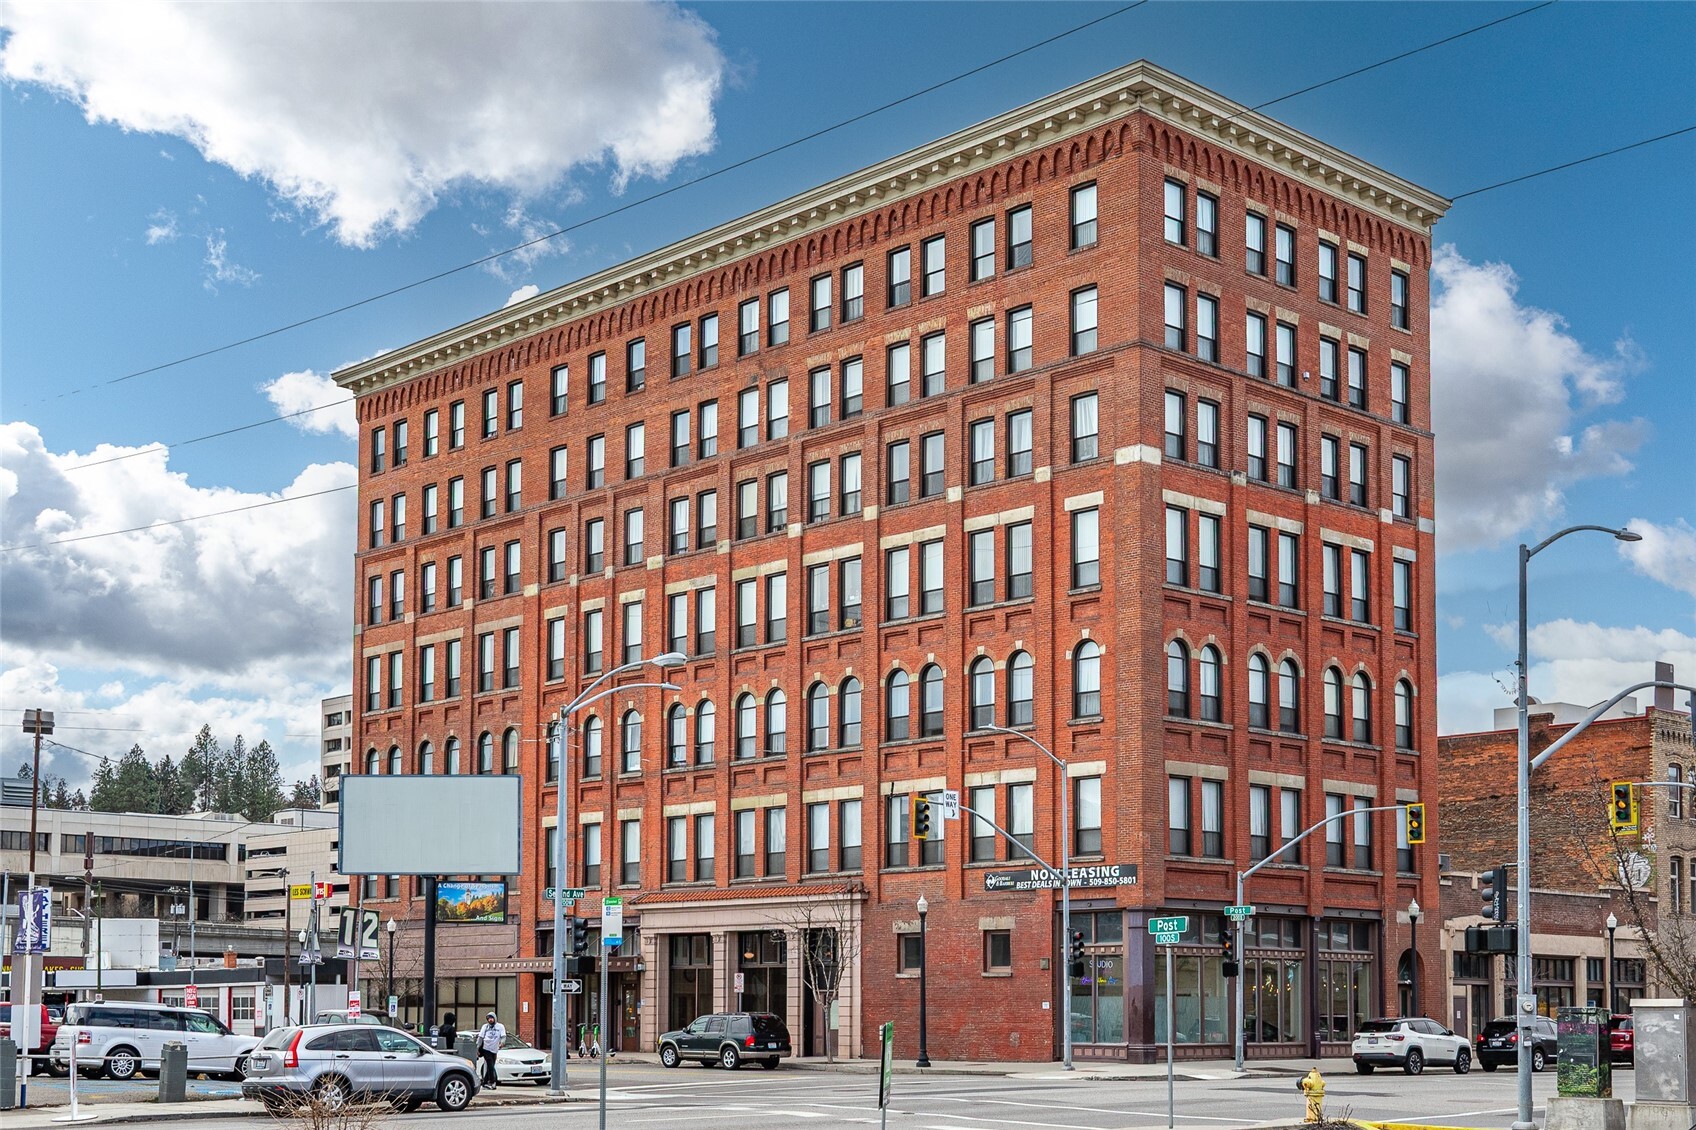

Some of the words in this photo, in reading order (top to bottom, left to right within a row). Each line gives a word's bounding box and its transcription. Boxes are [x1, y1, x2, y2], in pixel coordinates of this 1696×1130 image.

[945, 793, 957, 801] ONE
[1016, 881, 1031, 889] BEST
[1031, 880, 1053, 889] DEALS
[1053, 880, 1061, 888] IN
[1089, 876, 1136, 886] 509-850-5801
[548, 889, 571, 898] Send
[572, 890, 584, 898] Ave
[1157, 919, 1178, 931] Post
[1160, 934, 1176, 942] 100S
[1089, 960, 1114, 969] SUDIO
